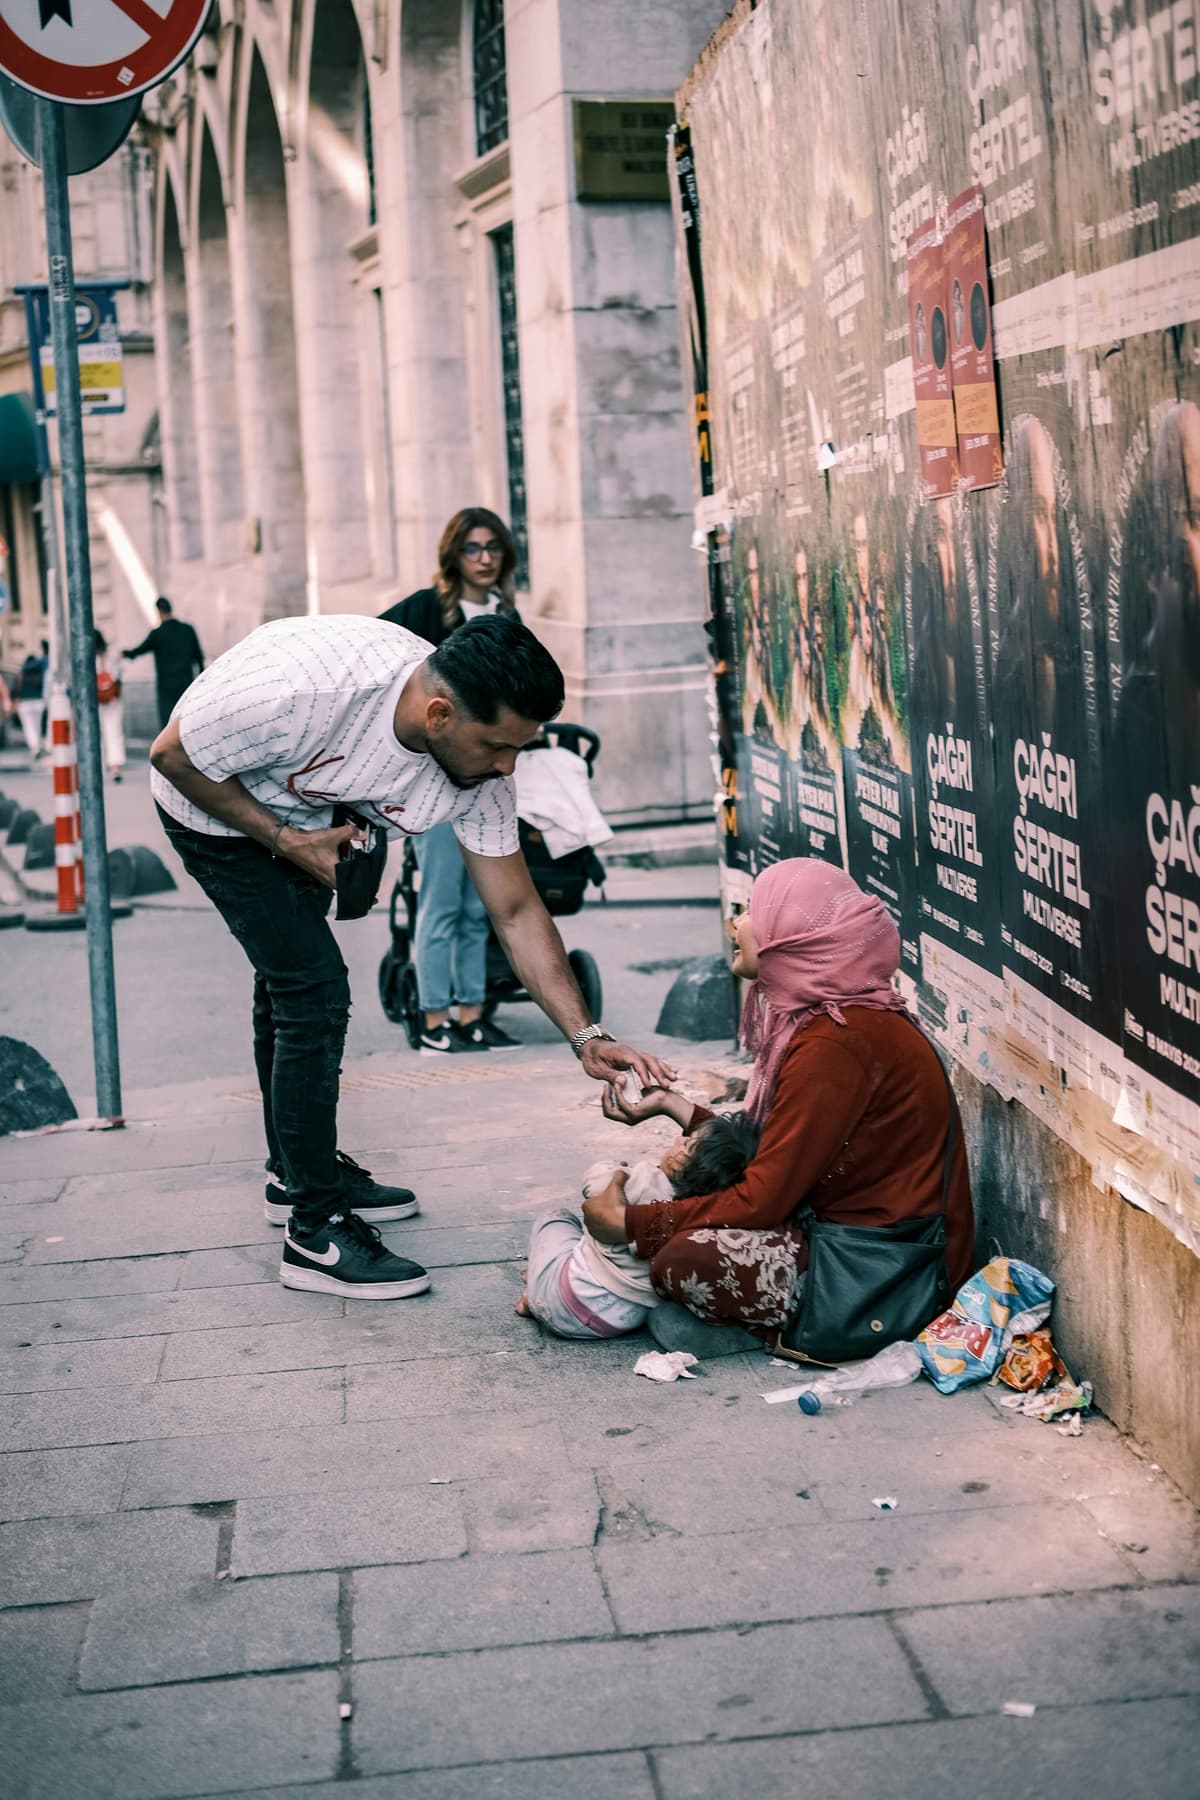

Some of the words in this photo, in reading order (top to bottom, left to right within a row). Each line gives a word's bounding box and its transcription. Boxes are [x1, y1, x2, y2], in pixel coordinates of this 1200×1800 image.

[1094, 0, 1200, 125] SERTE
[927, 722, 973, 799] ÇAĞRI
[1014, 731, 1078, 819] ÇAĞRI
[929, 800, 983, 866] SERTEL
[1013, 815, 1090, 909] SERTEL
[936, 863, 978, 903] MULTIVERSE
[1022, 889, 1082, 949] MULTIVERSE
